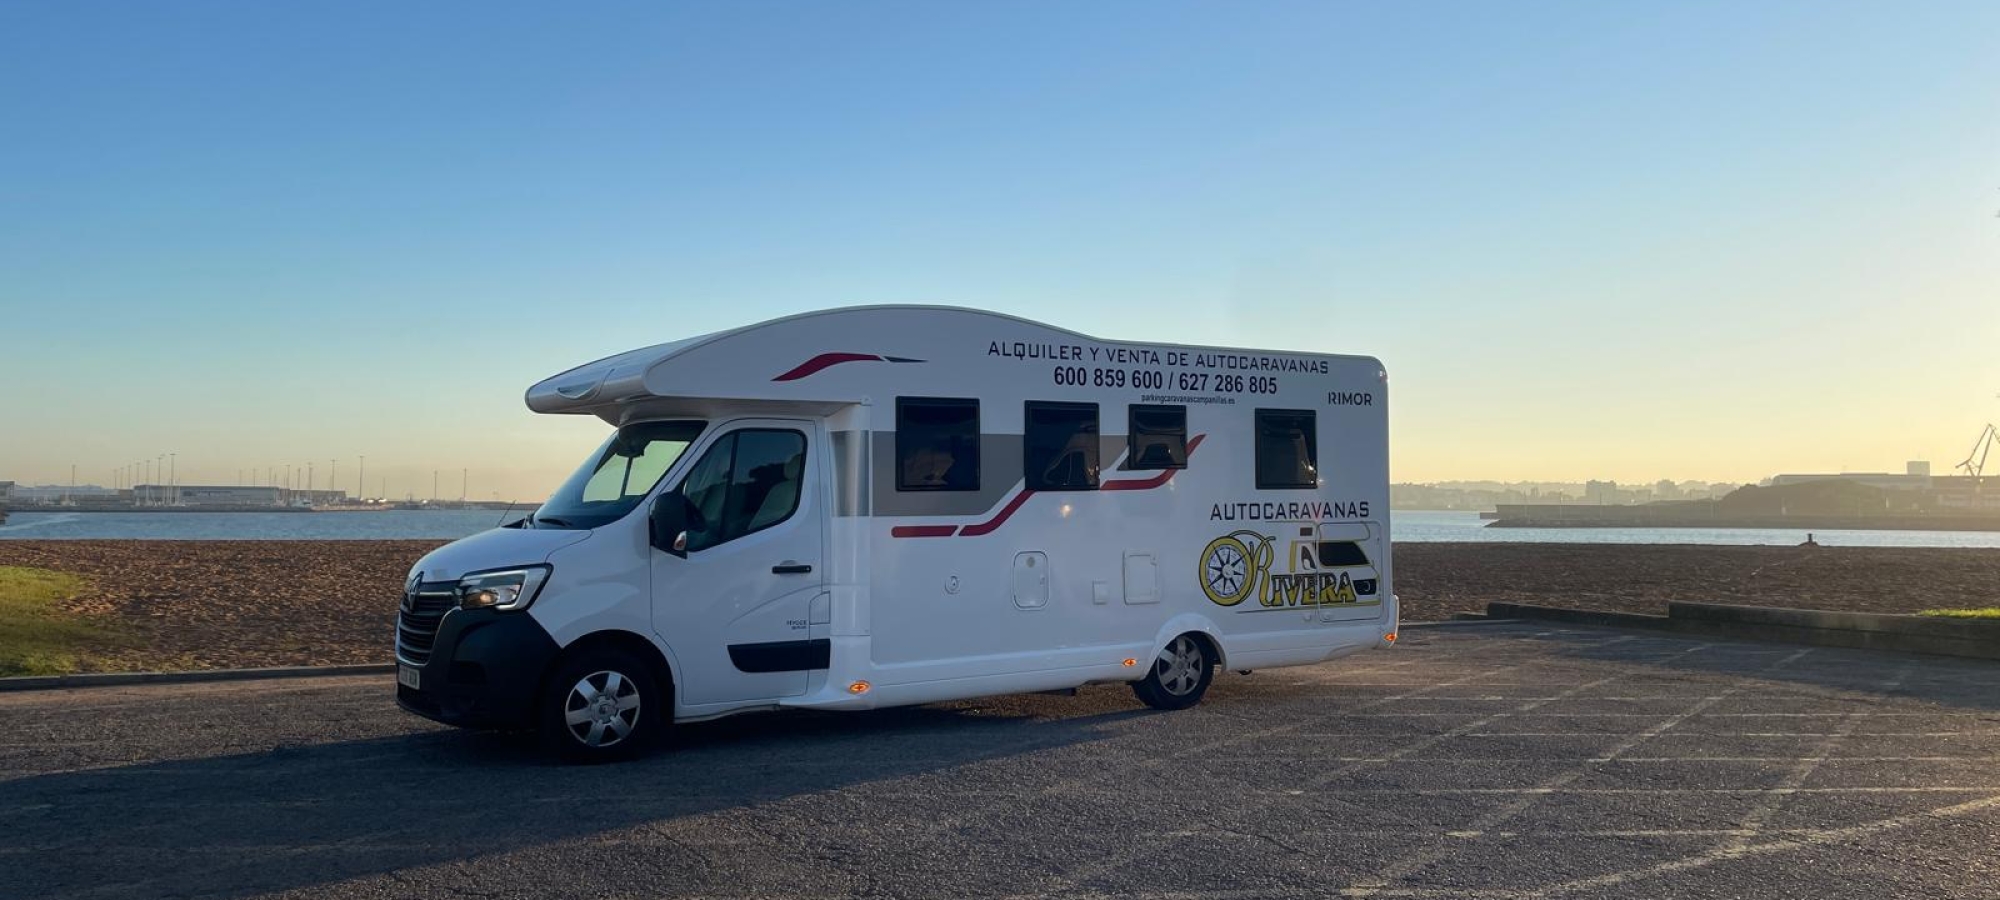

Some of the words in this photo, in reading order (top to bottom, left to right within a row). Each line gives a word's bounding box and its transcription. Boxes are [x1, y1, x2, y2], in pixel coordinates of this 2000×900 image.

[988, 340, 1083, 361] ALQUILER
[1089, 347, 1099, 361] Y
[1106, 348, 1161, 365] VENTA
[1167, 352, 1189, 367] DE
[1195, 353, 1329, 375] AUTOCARAVANAS
[1054, 366, 1087, 386] 600
[1093, 368, 1126, 388] 859
[1131, 369, 1163, 390] 600
[1168, 371, 1174, 390] /
[1179, 372, 1209, 391] 627
[1214, 374, 1243, 393] 286
[1249, 376, 1277, 395] 805
[1327, 391, 1373, 407] RIMOR
[1210, 502, 1370, 521] AUTOCARAVANAS
[1238, 530, 1357, 607] RIVERA
